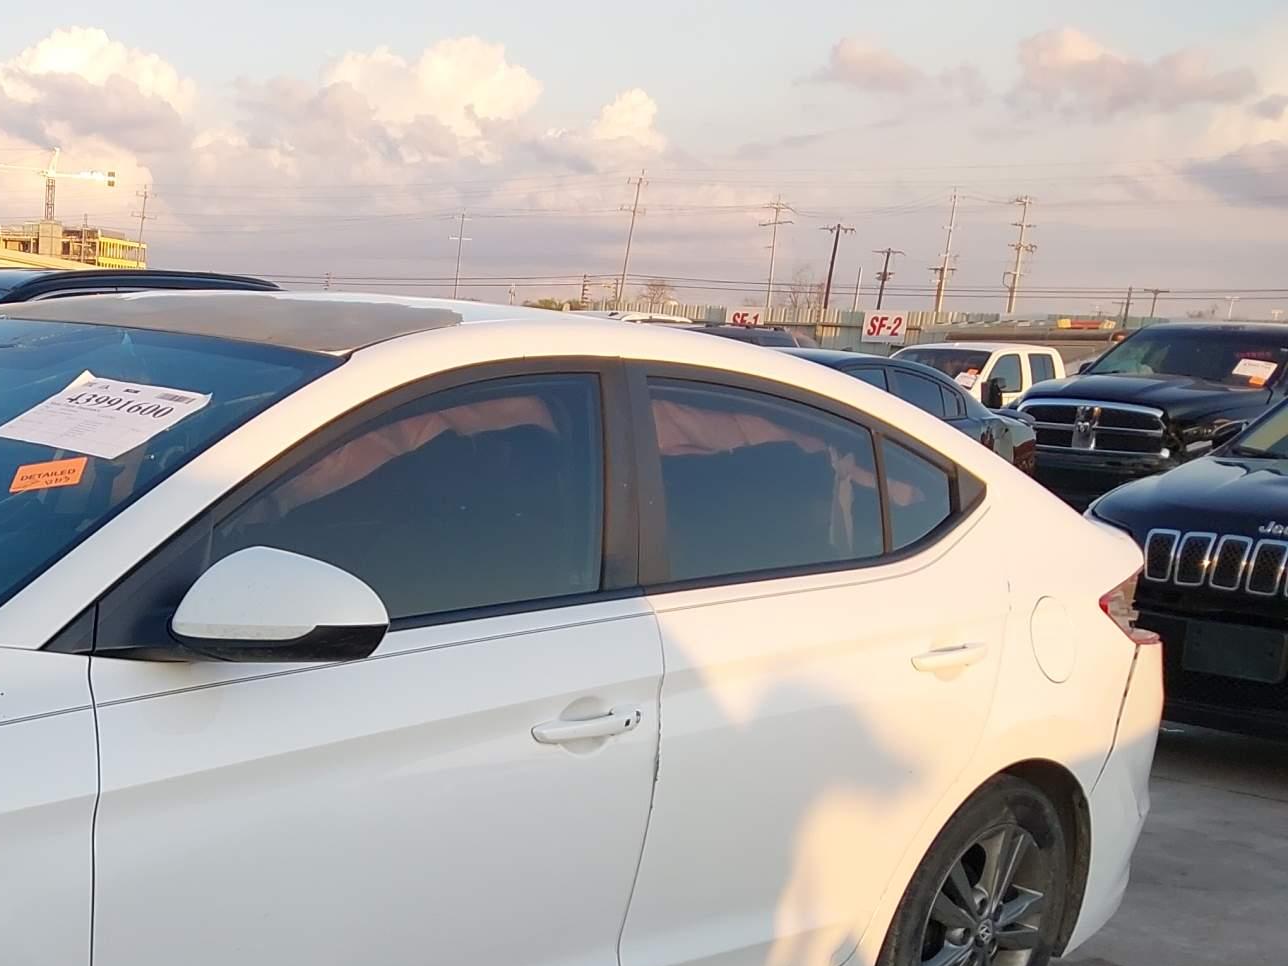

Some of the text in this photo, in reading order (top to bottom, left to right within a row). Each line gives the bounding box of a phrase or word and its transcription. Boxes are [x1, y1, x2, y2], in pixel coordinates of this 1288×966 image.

[867, 316, 903, 336] SF-2
[67, 392, 174, 419] 43991600
[20, 468, 76, 481] DETAILED
